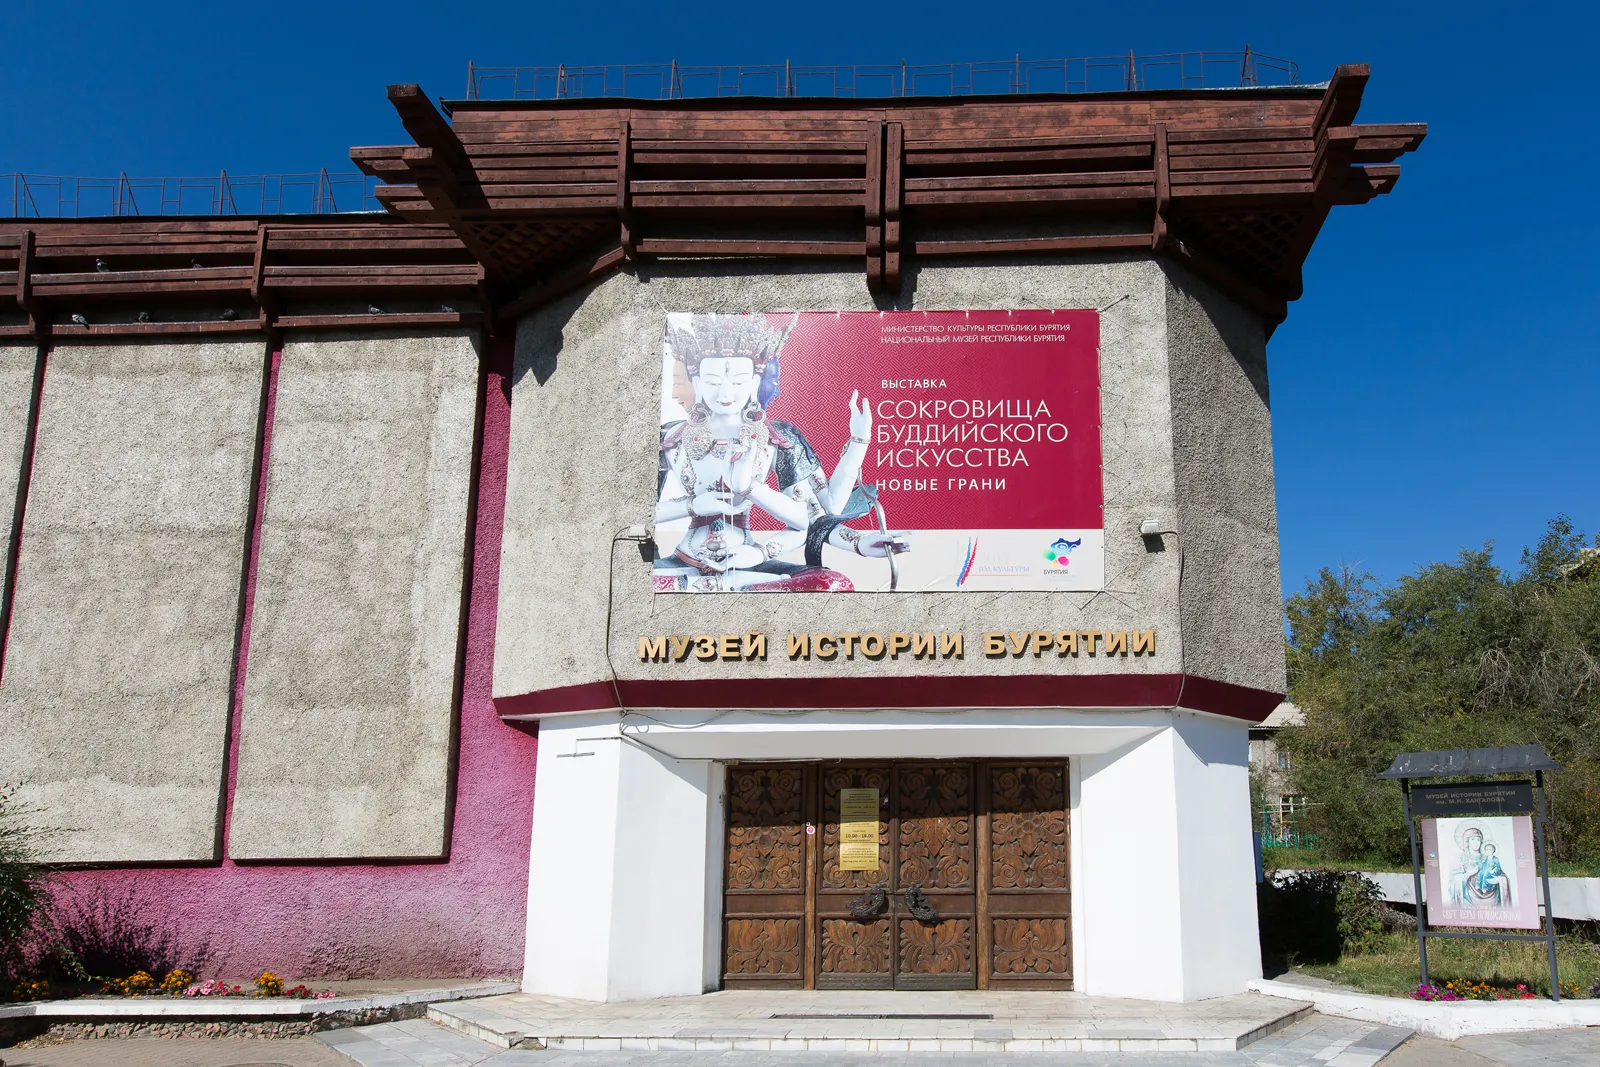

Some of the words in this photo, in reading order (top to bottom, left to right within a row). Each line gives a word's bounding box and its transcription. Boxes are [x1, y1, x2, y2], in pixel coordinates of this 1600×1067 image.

[881, 325, 944, 333] МИНИСТЕРСТВО
[947, 324, 985, 332] КУЛЬТУРЫ
[987, 324, 1037, 332] РЕСПУБЛИКИ
[880, 335, 950, 344] НАЦИОНАЛЬНЫЙ
[952, 334, 978, 343] МУЗЕЙ
[980, 335, 1032, 343] РЕСПУБЛИКИ
[881, 379, 947, 389] ВЫСТАВКА
[877, 399, 1052, 421] СОКРОВИЩА
[877, 420, 1069, 446] БУДДИЙСКОГО
[877, 448, 1029, 468] ИСКУССТВА
[876, 478, 938, 491] НОВЫЕ
[948, 478, 1006, 490] ГРАНИ
[638, 630, 767, 659] МУЗЕЙ
[787, 632, 964, 658] ИСТОРИИ
[984, 629, 1156, 656] БУРЯТИИ
